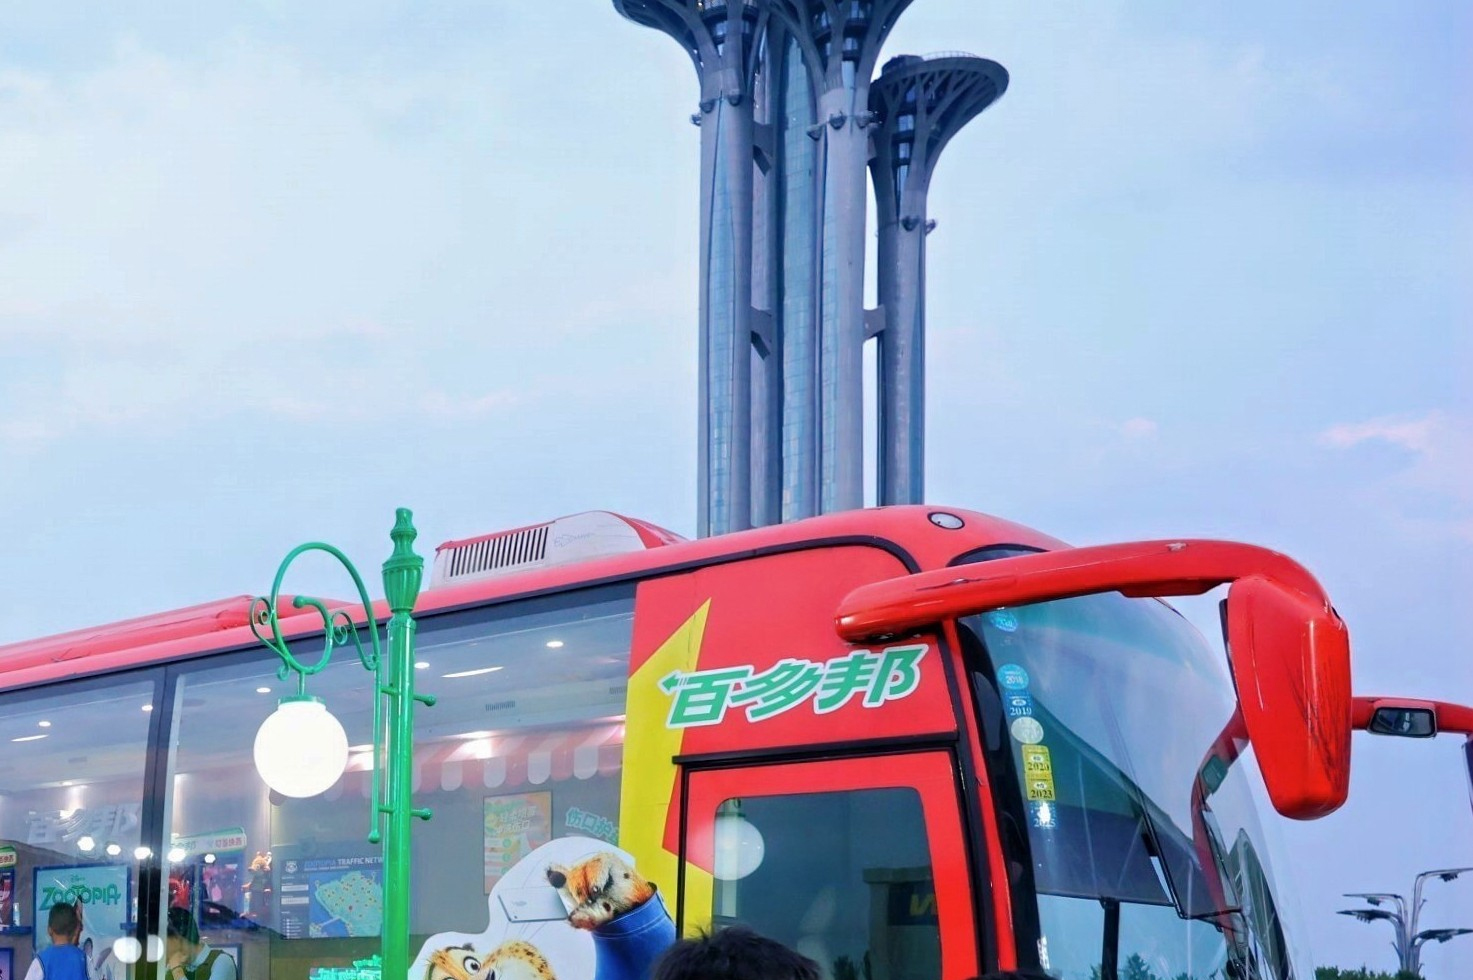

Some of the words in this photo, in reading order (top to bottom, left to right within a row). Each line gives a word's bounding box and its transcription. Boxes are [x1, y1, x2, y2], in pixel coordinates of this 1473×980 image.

[660, 646, 926, 727] 百多邦
[1010, 706, 1032, 716] 2019
[1031, 789, 1053, 799] 2023
[39, 883, 121, 911] ZOOTOPIA
